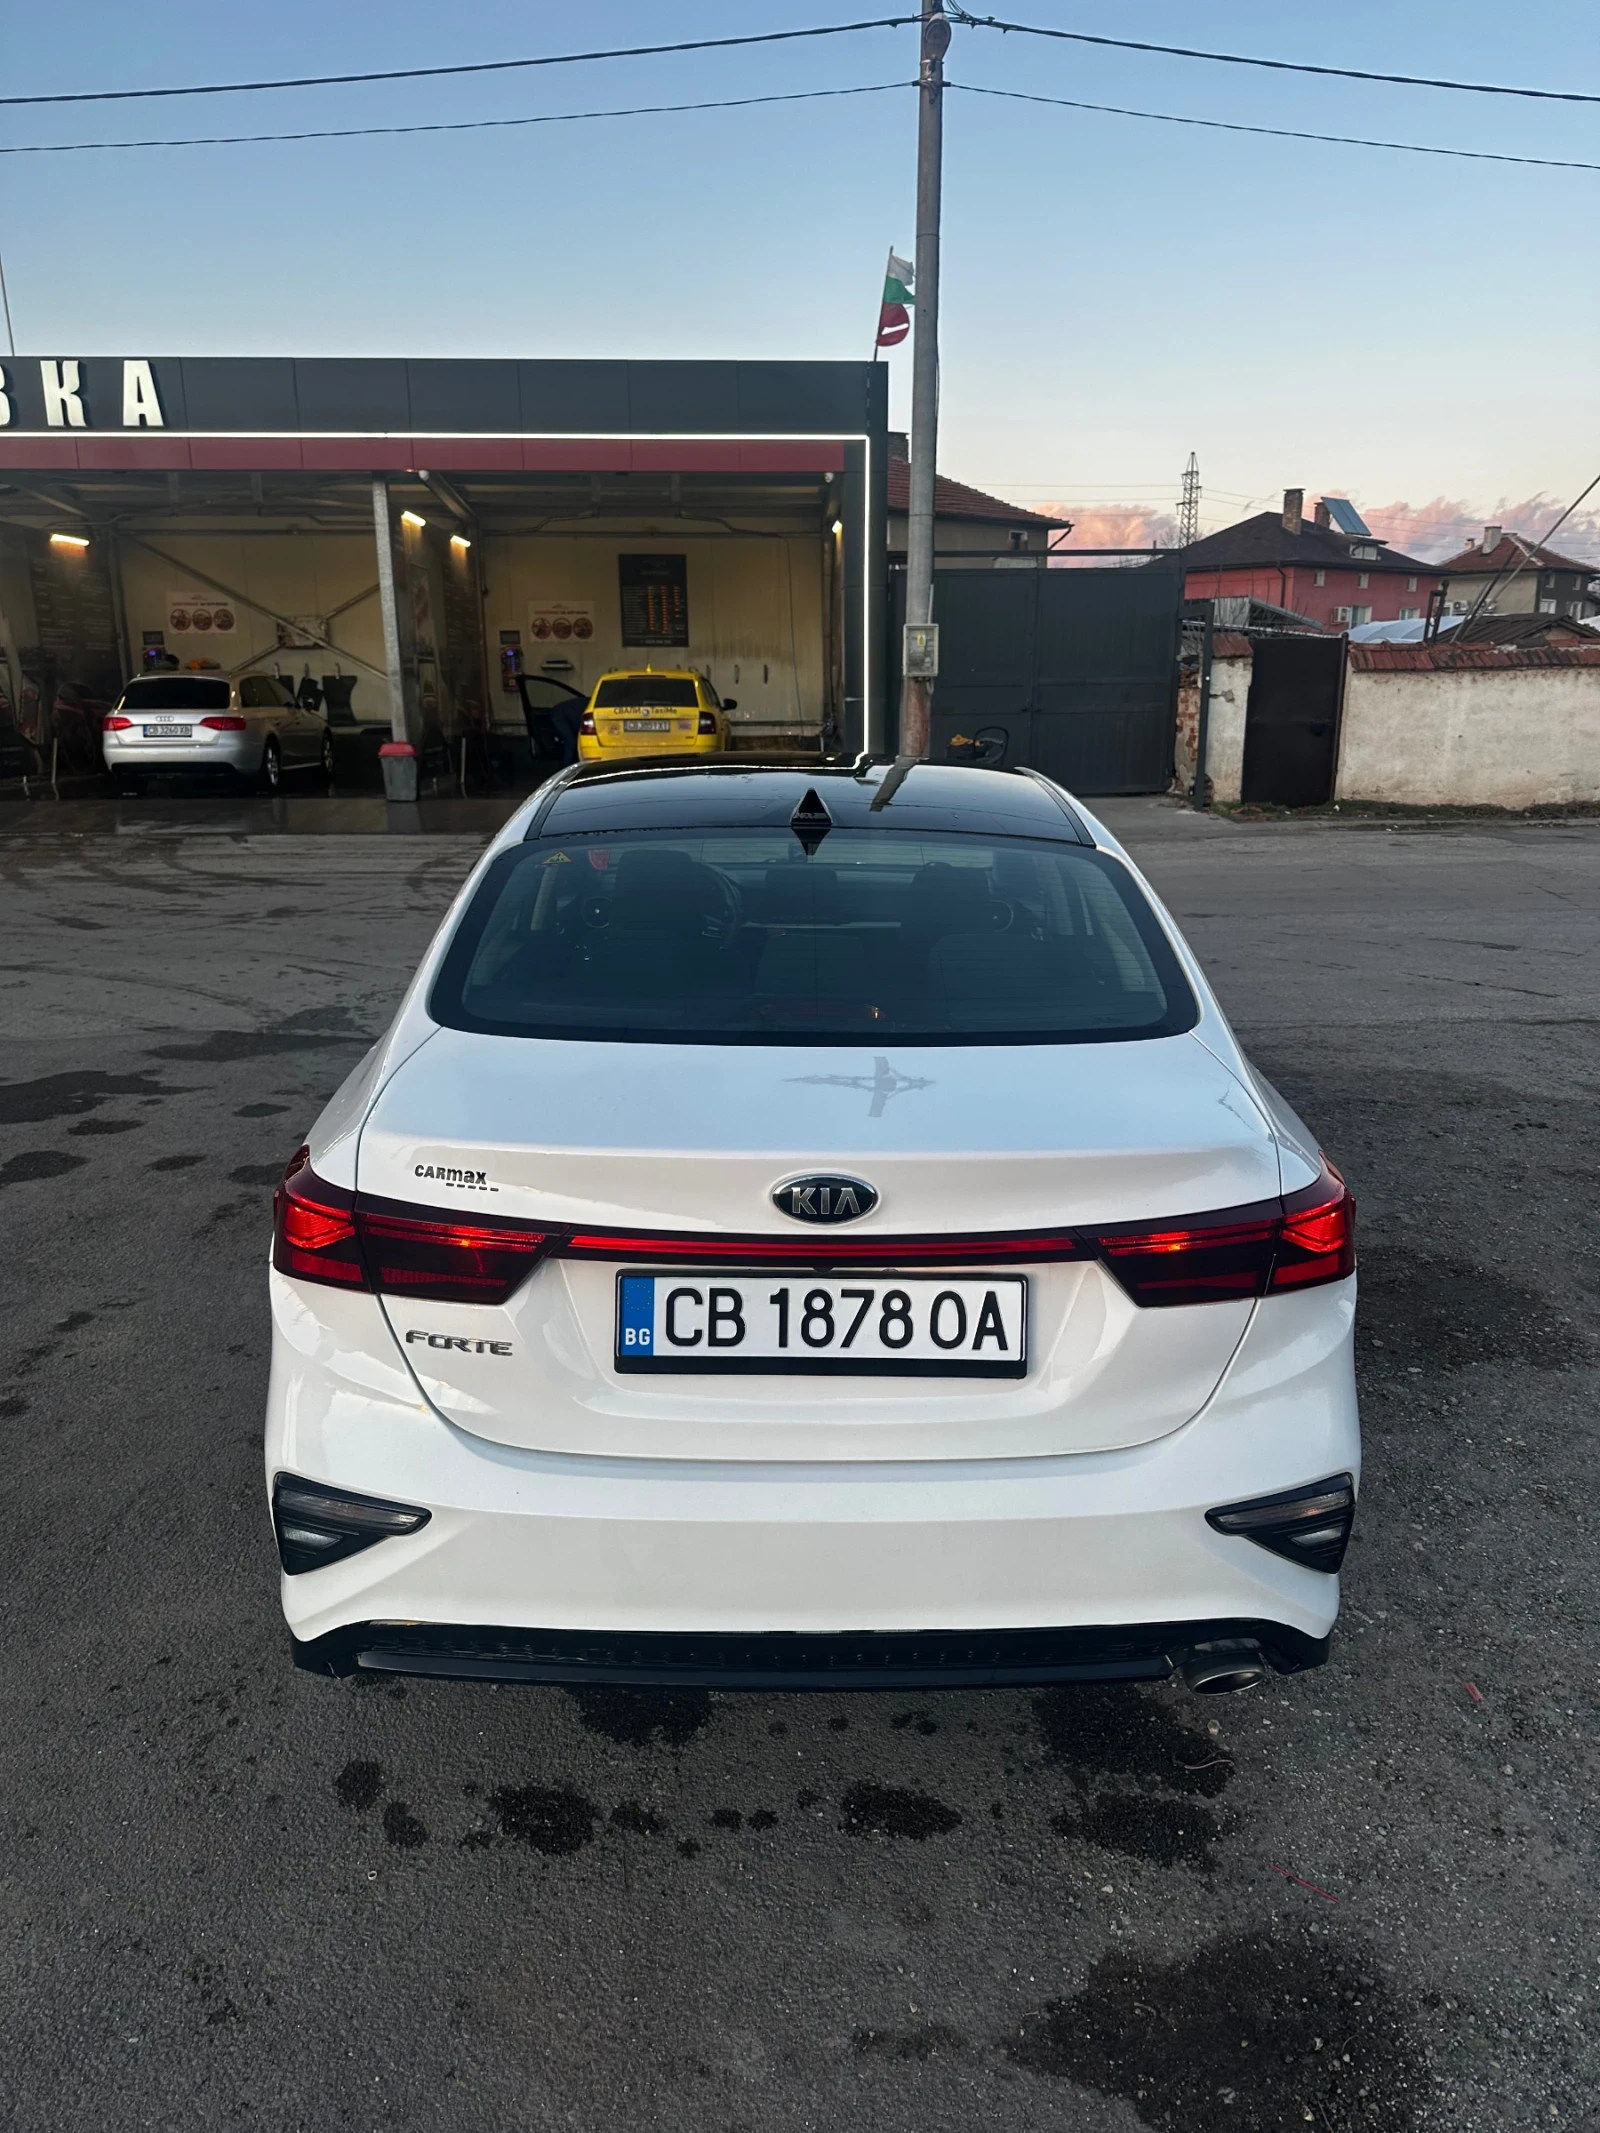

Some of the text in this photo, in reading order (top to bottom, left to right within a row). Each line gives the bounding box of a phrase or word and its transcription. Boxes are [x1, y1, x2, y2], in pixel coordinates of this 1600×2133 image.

[414, 1164, 487, 1185] CARmax
[791, 1187, 861, 1215] KIA
[665, 1287, 1009, 1351] CB 1878 OA
[405, 1329, 513, 1357] FORTE
[625, 1328, 651, 1346] BG
